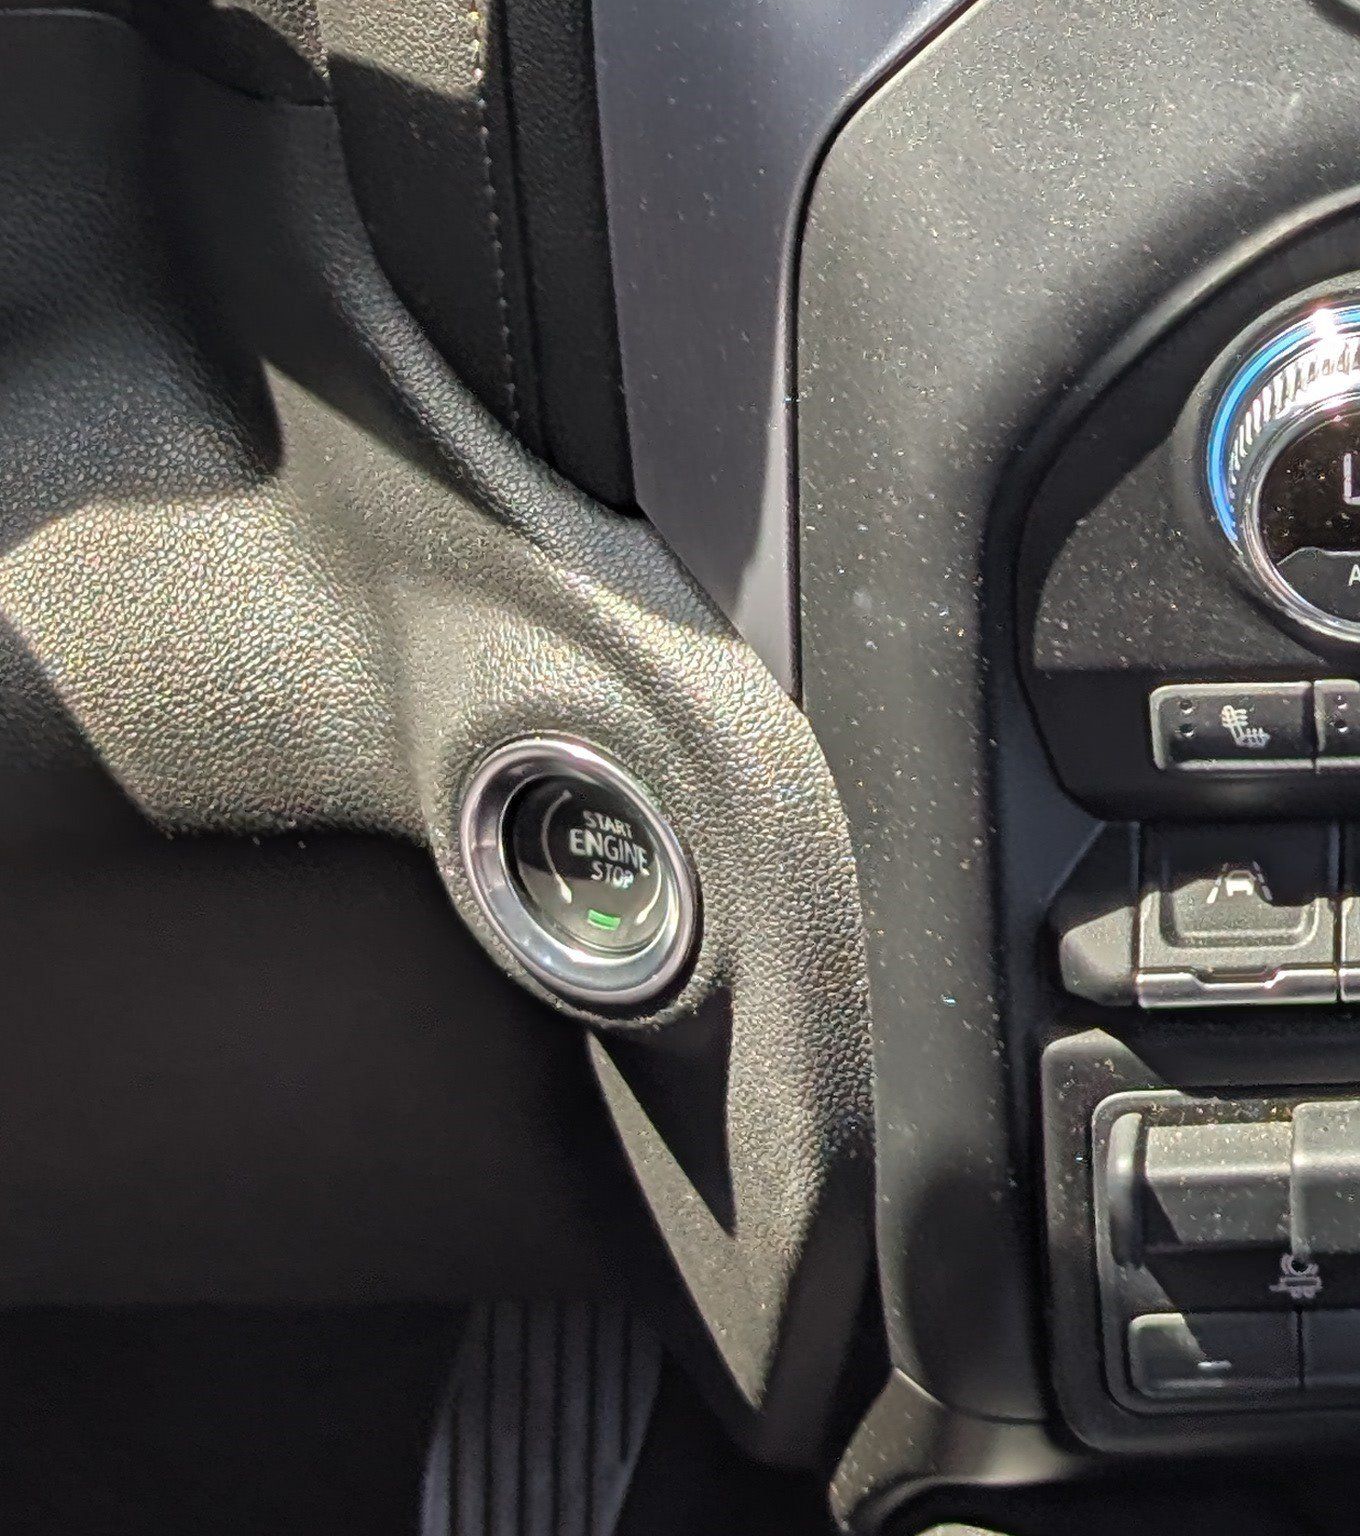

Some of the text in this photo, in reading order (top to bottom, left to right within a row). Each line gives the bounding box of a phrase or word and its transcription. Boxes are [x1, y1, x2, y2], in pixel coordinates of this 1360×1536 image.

[583, 810, 633, 839] START
[569, 828, 650, 877] ENGINE
[591, 860, 635, 888] STOP
